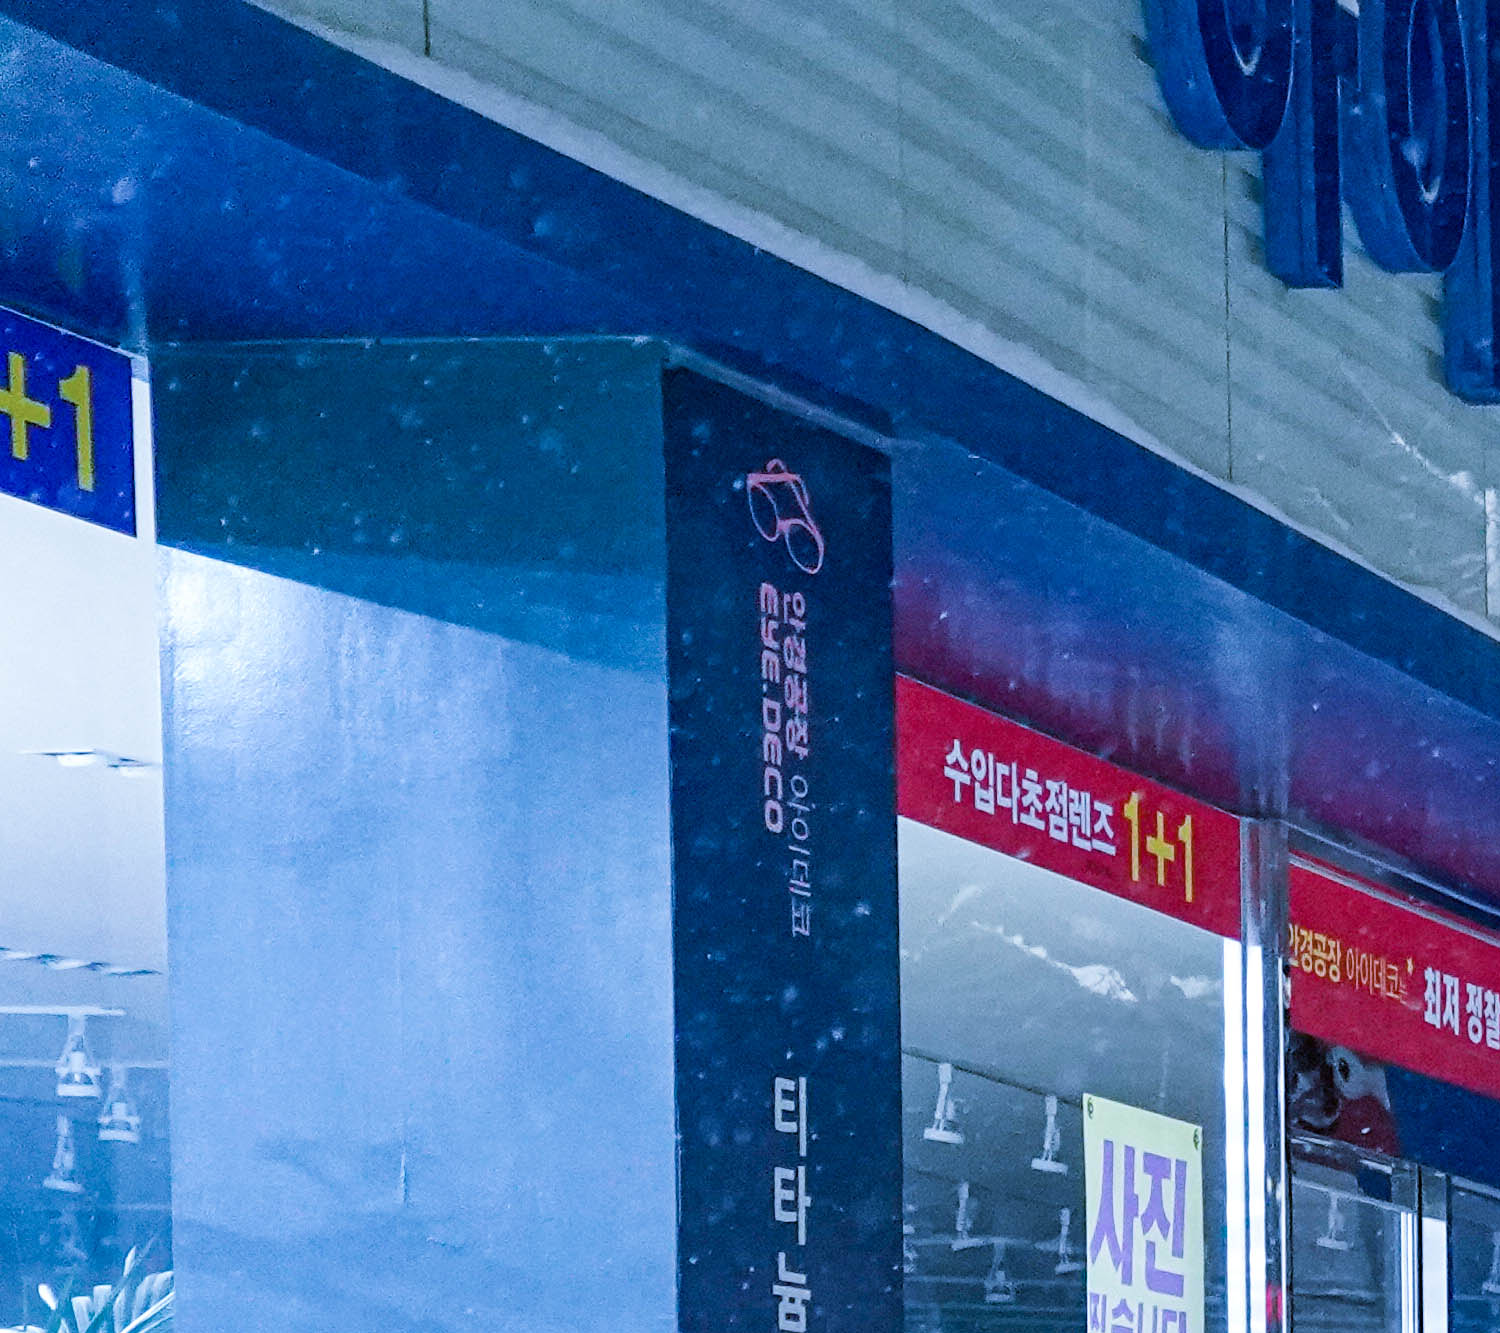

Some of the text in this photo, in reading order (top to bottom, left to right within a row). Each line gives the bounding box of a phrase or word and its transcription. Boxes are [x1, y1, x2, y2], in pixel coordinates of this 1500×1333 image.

[943, 738, 1194, 903] 수입다초점렌즈 1+1
[1424, 966, 1460, 1037] 최저
[1090, 1139, 1188, 1299] 사진
